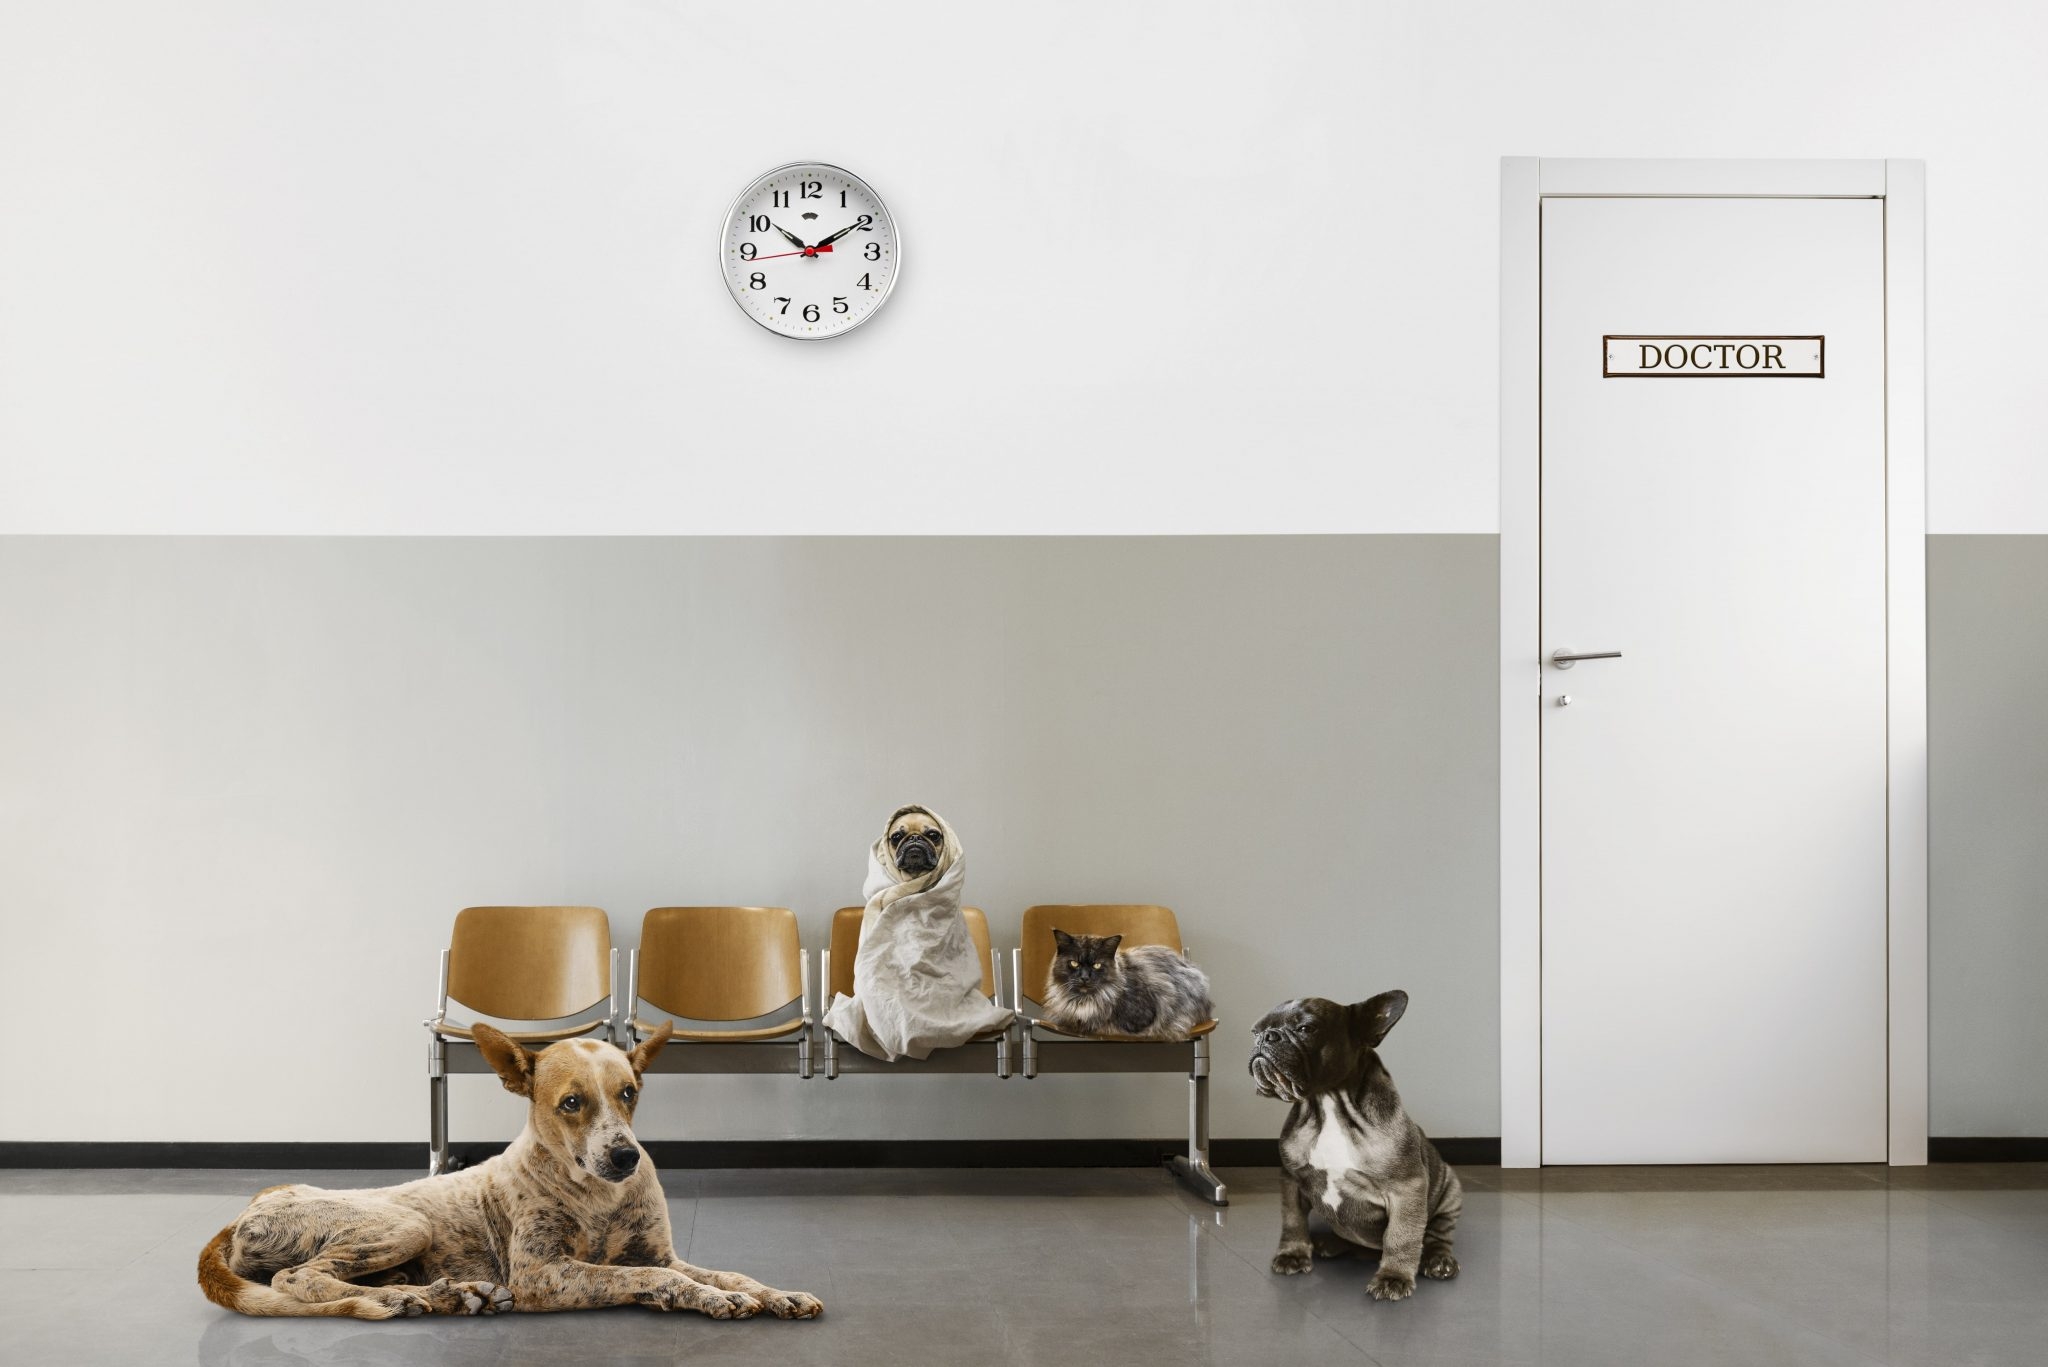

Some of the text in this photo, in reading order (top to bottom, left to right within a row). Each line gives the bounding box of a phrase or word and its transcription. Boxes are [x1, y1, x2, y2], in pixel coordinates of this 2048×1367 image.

[772, 190, 790, 208] 11
[799, 181, 823, 199] 12
[839, 190, 848, 208] 1
[749, 214, 771, 233] 10
[857, 214, 874, 232] 2
[739, 242, 758, 261] 9
[863, 242, 881, 261] 3
[749, 271, 767, 290] 8
[856, 272, 873, 291] 4
[773, 296, 792, 315] 7
[802, 304, 821, 322] 6
[832, 296, 849, 314] 5
[1638, 344, 1787, 369] DOCTOR
